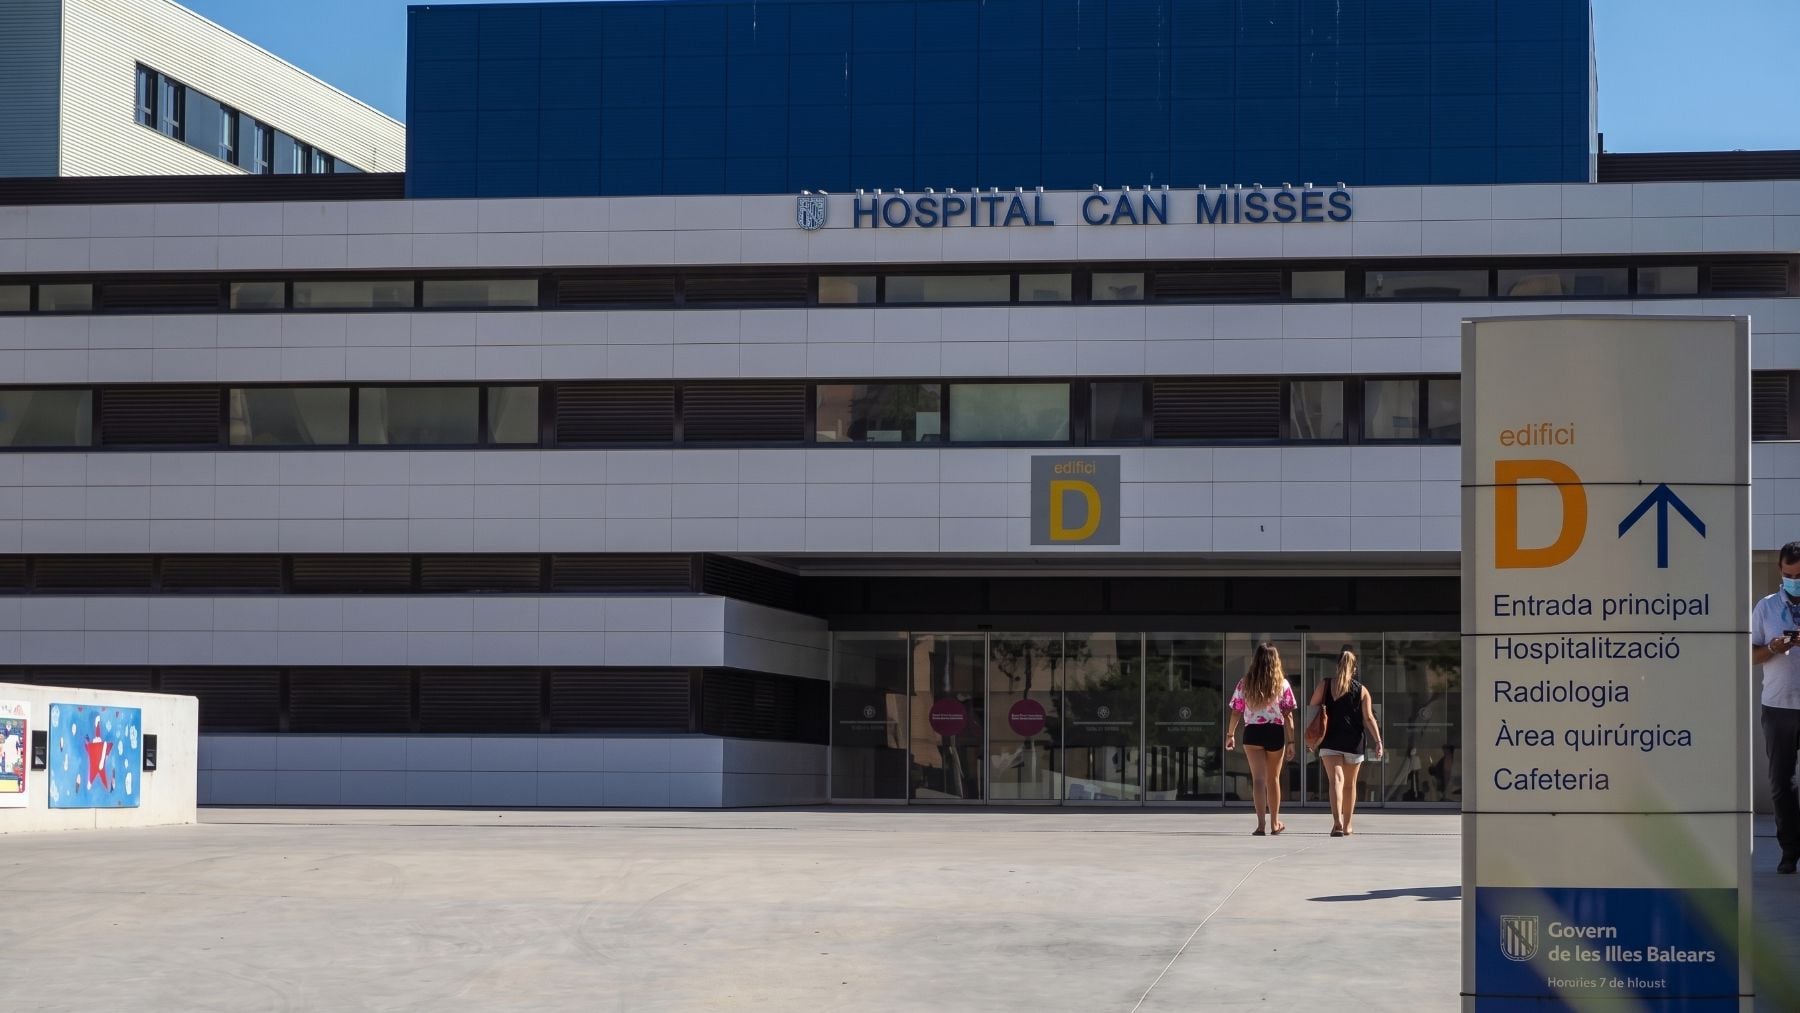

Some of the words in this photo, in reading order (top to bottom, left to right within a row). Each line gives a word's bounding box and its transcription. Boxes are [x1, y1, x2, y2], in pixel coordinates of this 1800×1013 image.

[853, 196, 1055, 228] HOSPITAL
[1082, 194, 1167, 225] CAN
[1196, 191, 1352, 224] MISSES
[1500, 423, 1575, 446] edifici
[1054, 460, 1096, 474] edifici
[1050, 480, 1101, 541] D
[1495, 459, 1588, 569] D
[1494, 594, 1593, 616] Entrada
[1602, 593, 1709, 620] principal
[1494, 636, 1680, 664] Hospitalització
[1494, 680, 1630, 708] Radiologia
[1495, 719, 1555, 747] Àrea
[1564, 723, 1692, 752] quirúrgica
[1494, 768, 1610, 790] Cafeteria
[1548, 922, 1617, 939] Govern
[1548, 946, 1571, 962] de
[1575, 945, 1601, 962] les
[1605, 946, 1642, 962] Illes
[1647, 946, 1716, 963] Balears
[1599, 977, 1607, 988] 7
[1609, 977, 1625, 988] de
